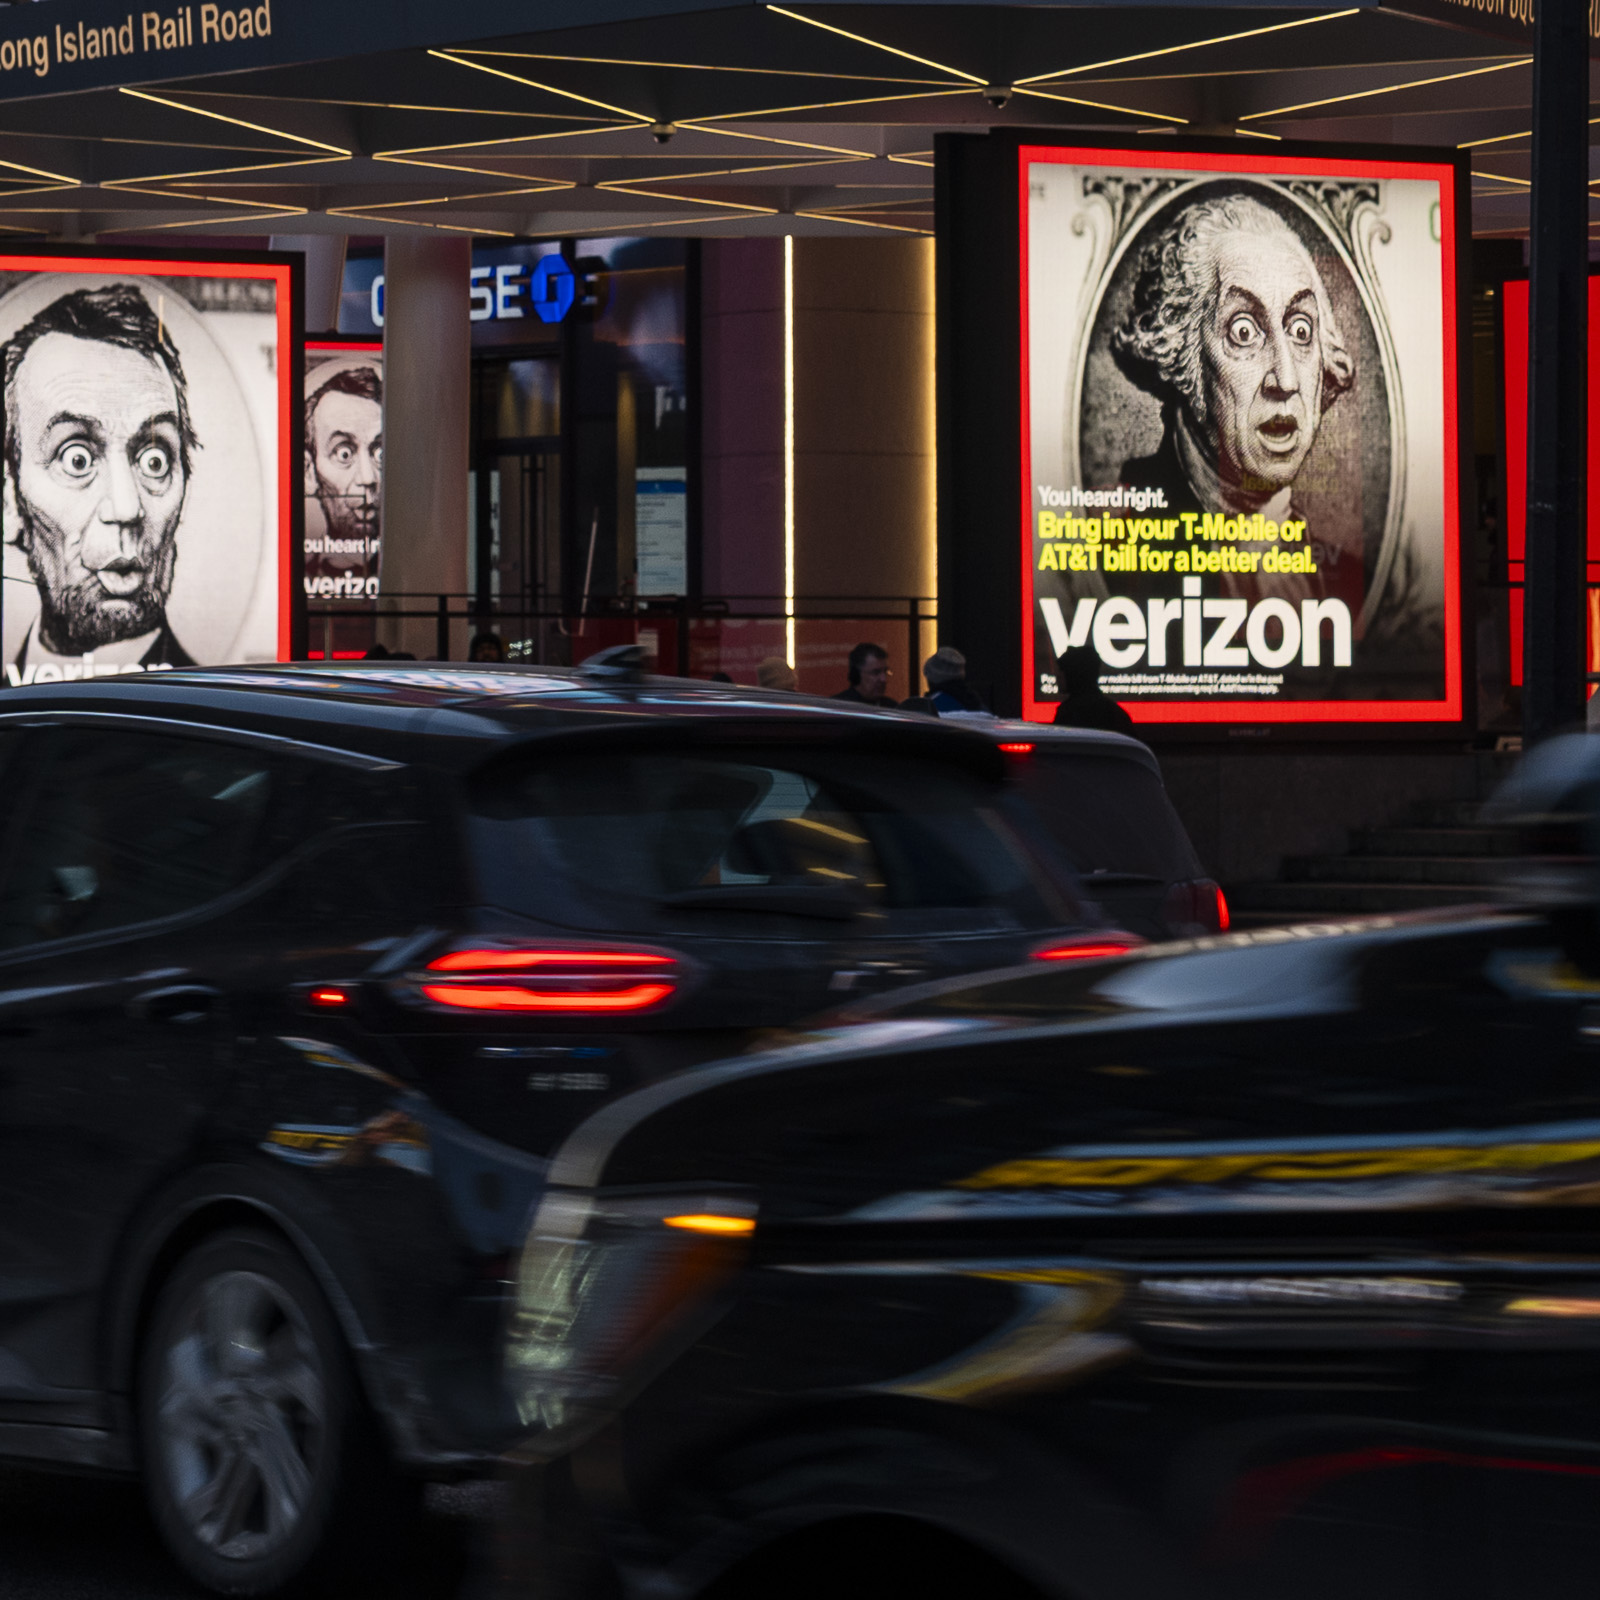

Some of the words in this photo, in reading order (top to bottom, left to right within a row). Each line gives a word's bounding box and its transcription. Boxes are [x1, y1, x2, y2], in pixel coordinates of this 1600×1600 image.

[55, 14, 134, 63] Island
[142, 6, 193, 51] Rail
[1038, 485, 1071, 507] You
[1072, 486, 1124, 507] heard
[1124, 485, 1168, 512] right.
[1038, 511, 1102, 544] Bring
[1103, 511, 1126, 540] in
[1126, 518, 1180, 544] your
[1180, 512, 1279, 542] T-Mobile
[1280, 520, 1306, 542] or
[304, 538, 323, 553] ou
[1038, 544, 1103, 571] AT&T
[1104, 544, 1138, 571] bill
[1138, 544, 1173, 572] for
[1174, 551, 1189, 572] a
[1190, 544, 1262, 573] better
[1262, 545, 1317, 573] deal.
[304, 571, 380, 599] verizo
[1040, 576, 1352, 668] verizon
[6, 652, 175, 687] veri
